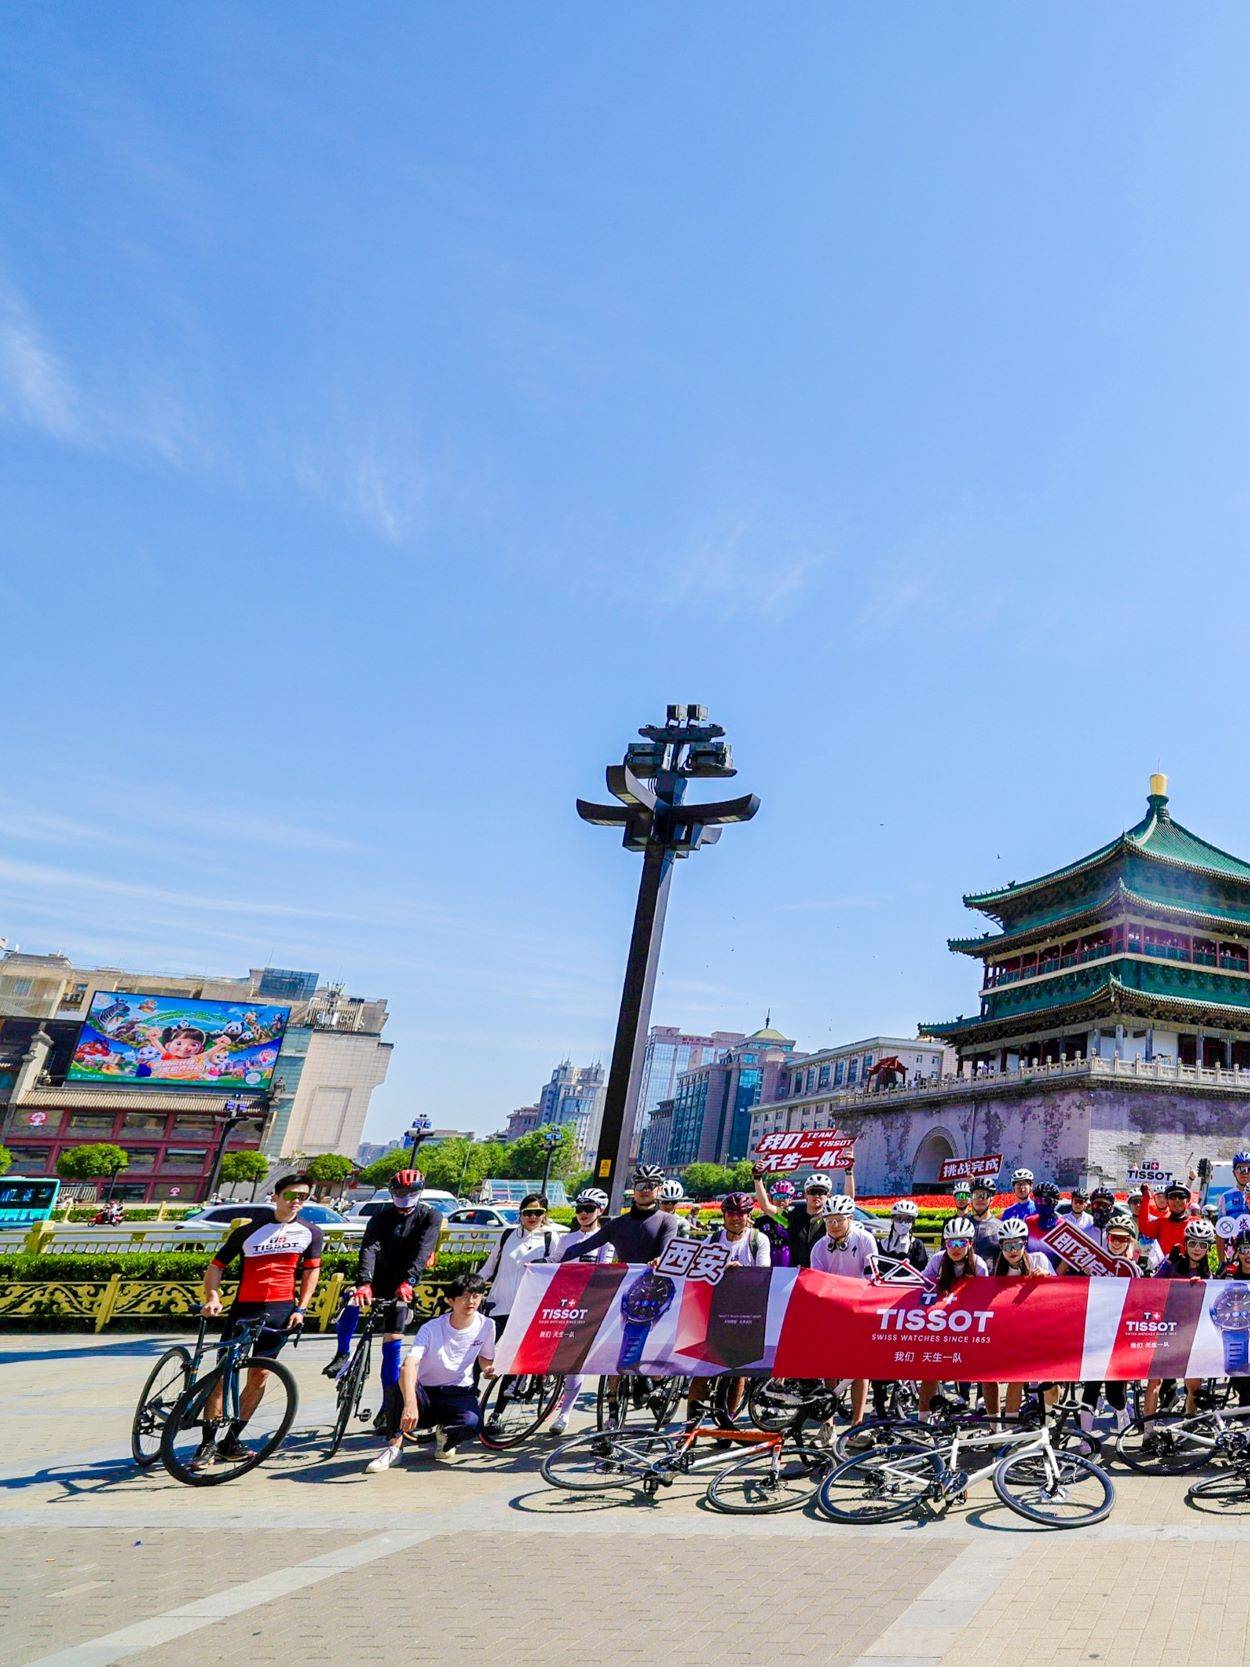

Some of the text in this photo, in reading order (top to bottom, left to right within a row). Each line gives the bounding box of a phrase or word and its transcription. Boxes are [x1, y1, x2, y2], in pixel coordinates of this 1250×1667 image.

[759, 1133, 803, 1152] 我们
[764, 1150, 840, 1171] 天生一队
[943, 1158, 999, 1178] 挑战完成
[1127, 1170, 1173, 1181] TISSOT
[253, 1242, 299, 1252] TISSOT
[1052, 1231, 1116, 1277] 即刻启
[659, 1242, 728, 1281] 西安
[922, 1293, 938, 1304] T
[542, 1309, 588, 1320] TISSOT
[876, 1308, 995, 1332] TISSOT
[1126, 1321, 1177, 1332] TISSOT
[871, 1333, 991, 1344] SWISS WATCHES SINCE 1853
[894, 1351, 962, 1363] 我们 天生一队
